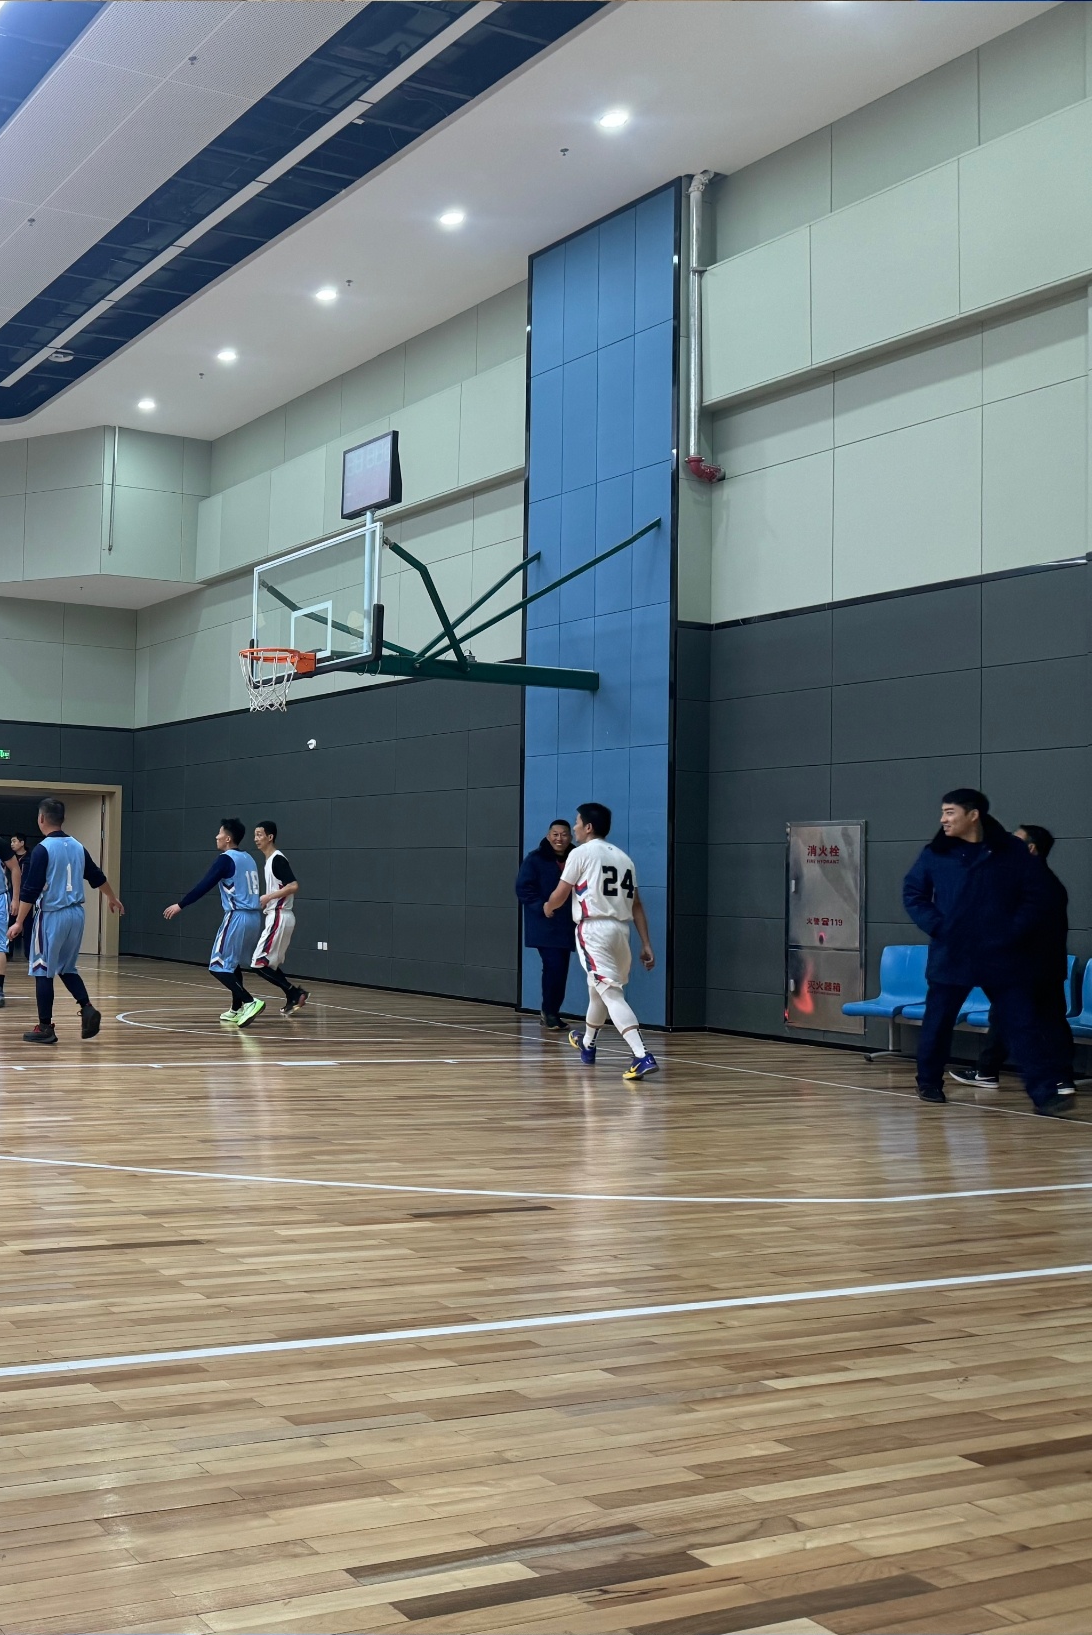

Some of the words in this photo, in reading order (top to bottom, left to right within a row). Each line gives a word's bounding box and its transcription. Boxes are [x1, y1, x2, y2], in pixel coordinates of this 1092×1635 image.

[807, 845, 840, 857] 消火栓
[66, 863, 73, 892] 1
[602, 865, 635, 899] 24
[830, 918, 843, 926] 119
[807, 980, 841, 993] 灭火器箱
